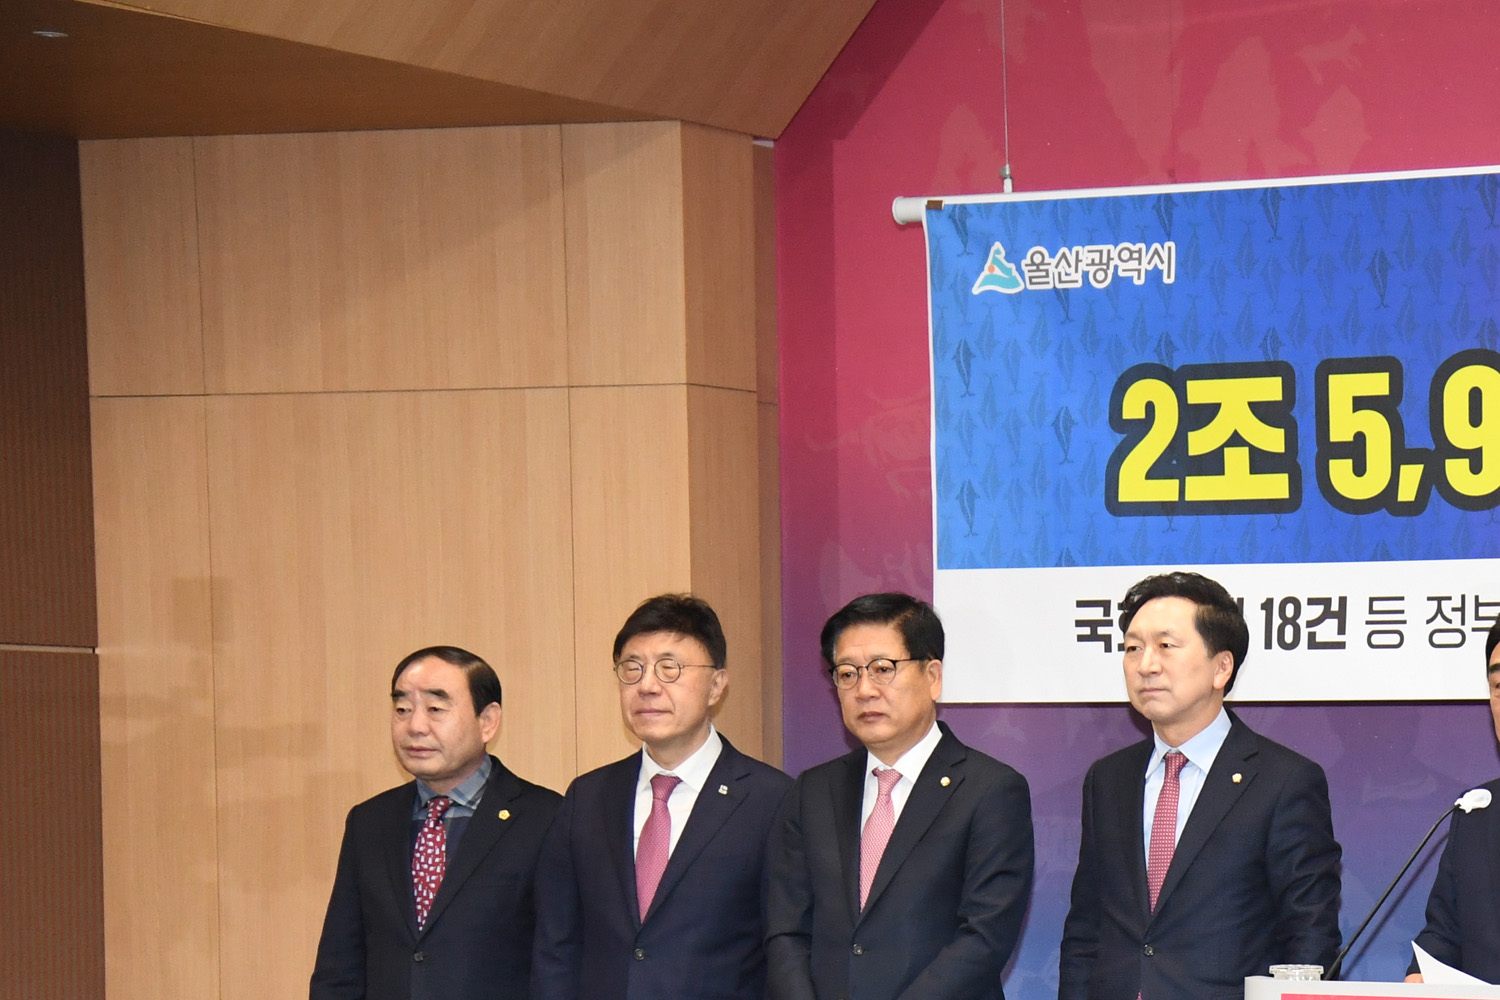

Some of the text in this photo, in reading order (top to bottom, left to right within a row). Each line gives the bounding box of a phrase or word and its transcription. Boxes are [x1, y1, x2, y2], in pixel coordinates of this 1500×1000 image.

[1022, 243, 1174, 288] 울산광역시
[1116, 374, 1291, 503] 2조
[1260, 595, 1348, 652] 18건
[1365, 595, 1407, 649] 등
